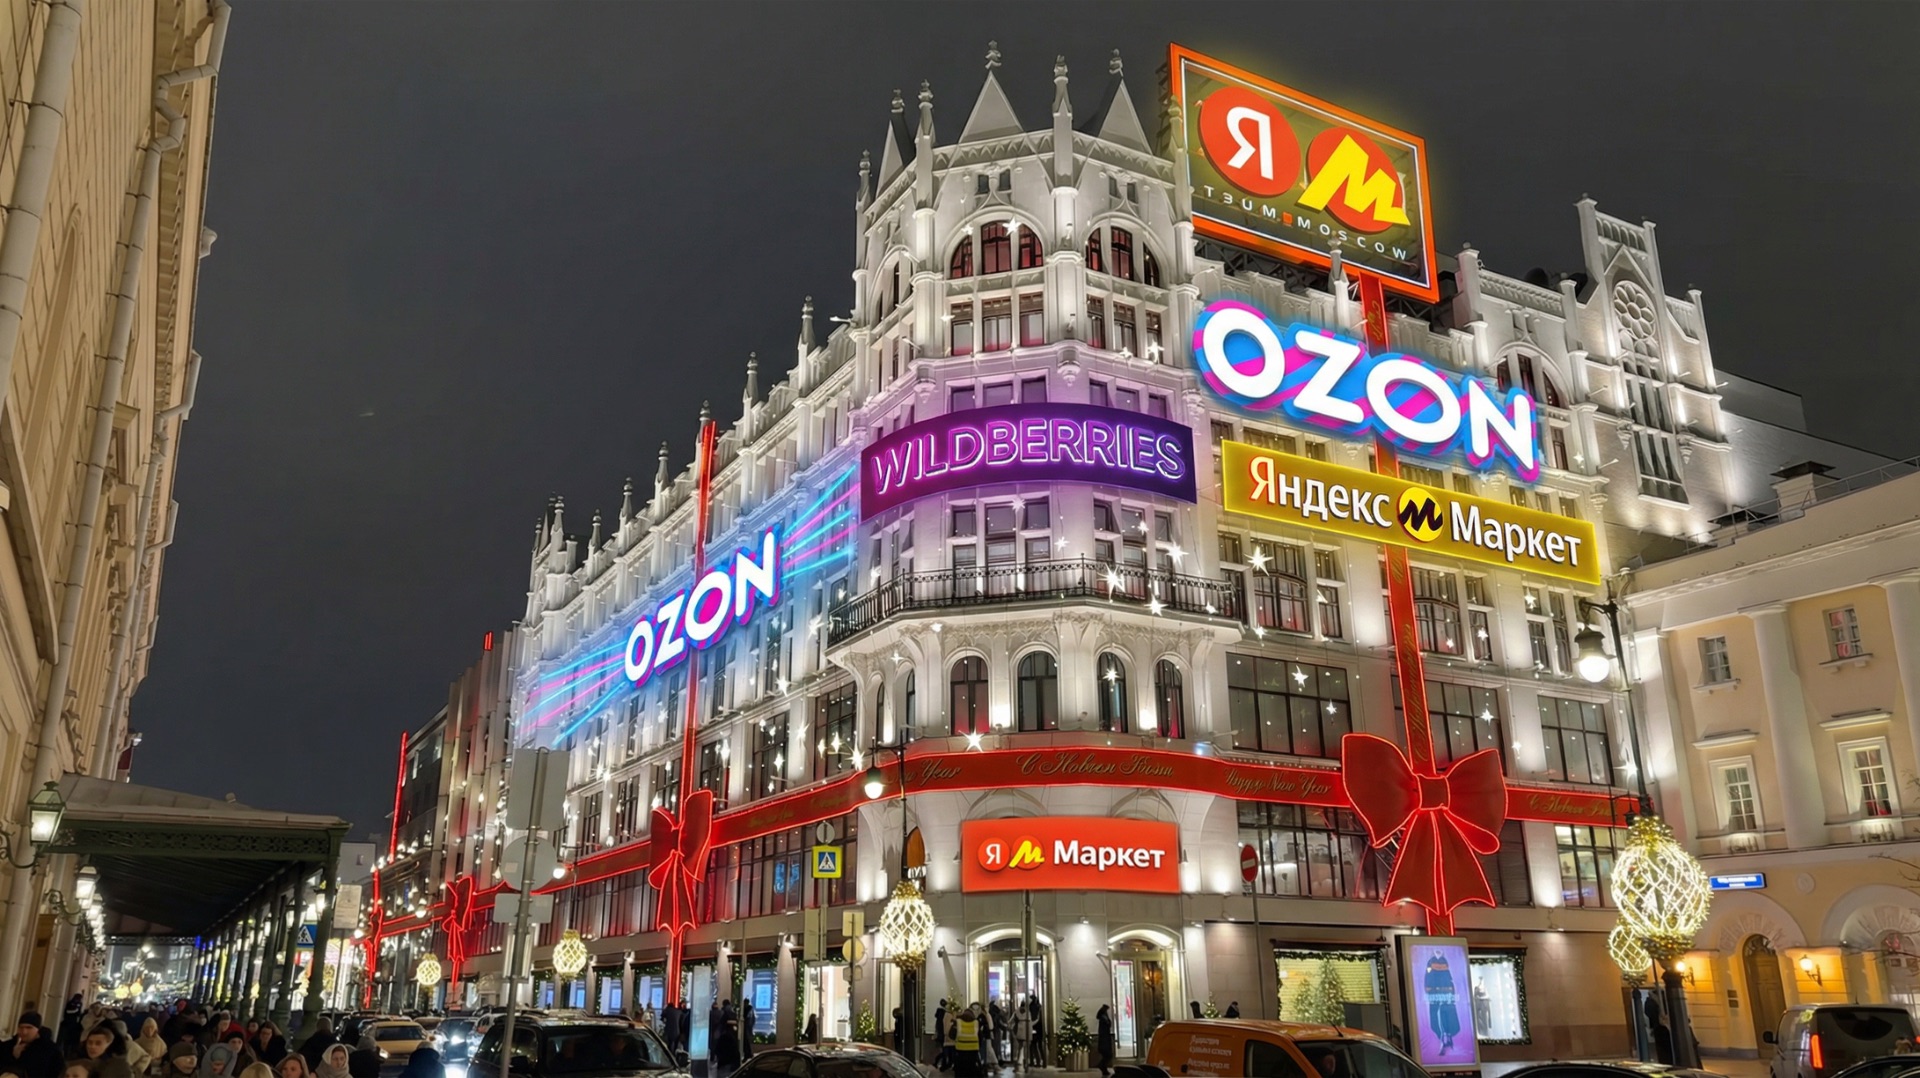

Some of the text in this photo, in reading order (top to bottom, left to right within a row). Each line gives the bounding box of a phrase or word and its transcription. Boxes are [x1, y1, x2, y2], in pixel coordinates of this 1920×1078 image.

[1226, 106, 1274, 180] Я
[1297, 215, 1406, 260] MOSCOW
[1201, 307, 1535, 472] OZON
[871, 418, 1186, 495] WILDBERRIES
[1249, 456, 1393, 529] Яндекс
[1450, 501, 1582, 567] Маркет
[624, 531, 775, 682] OZON
[986, 843, 1001, 865] Я
[1054, 840, 1165, 871] Маркет
